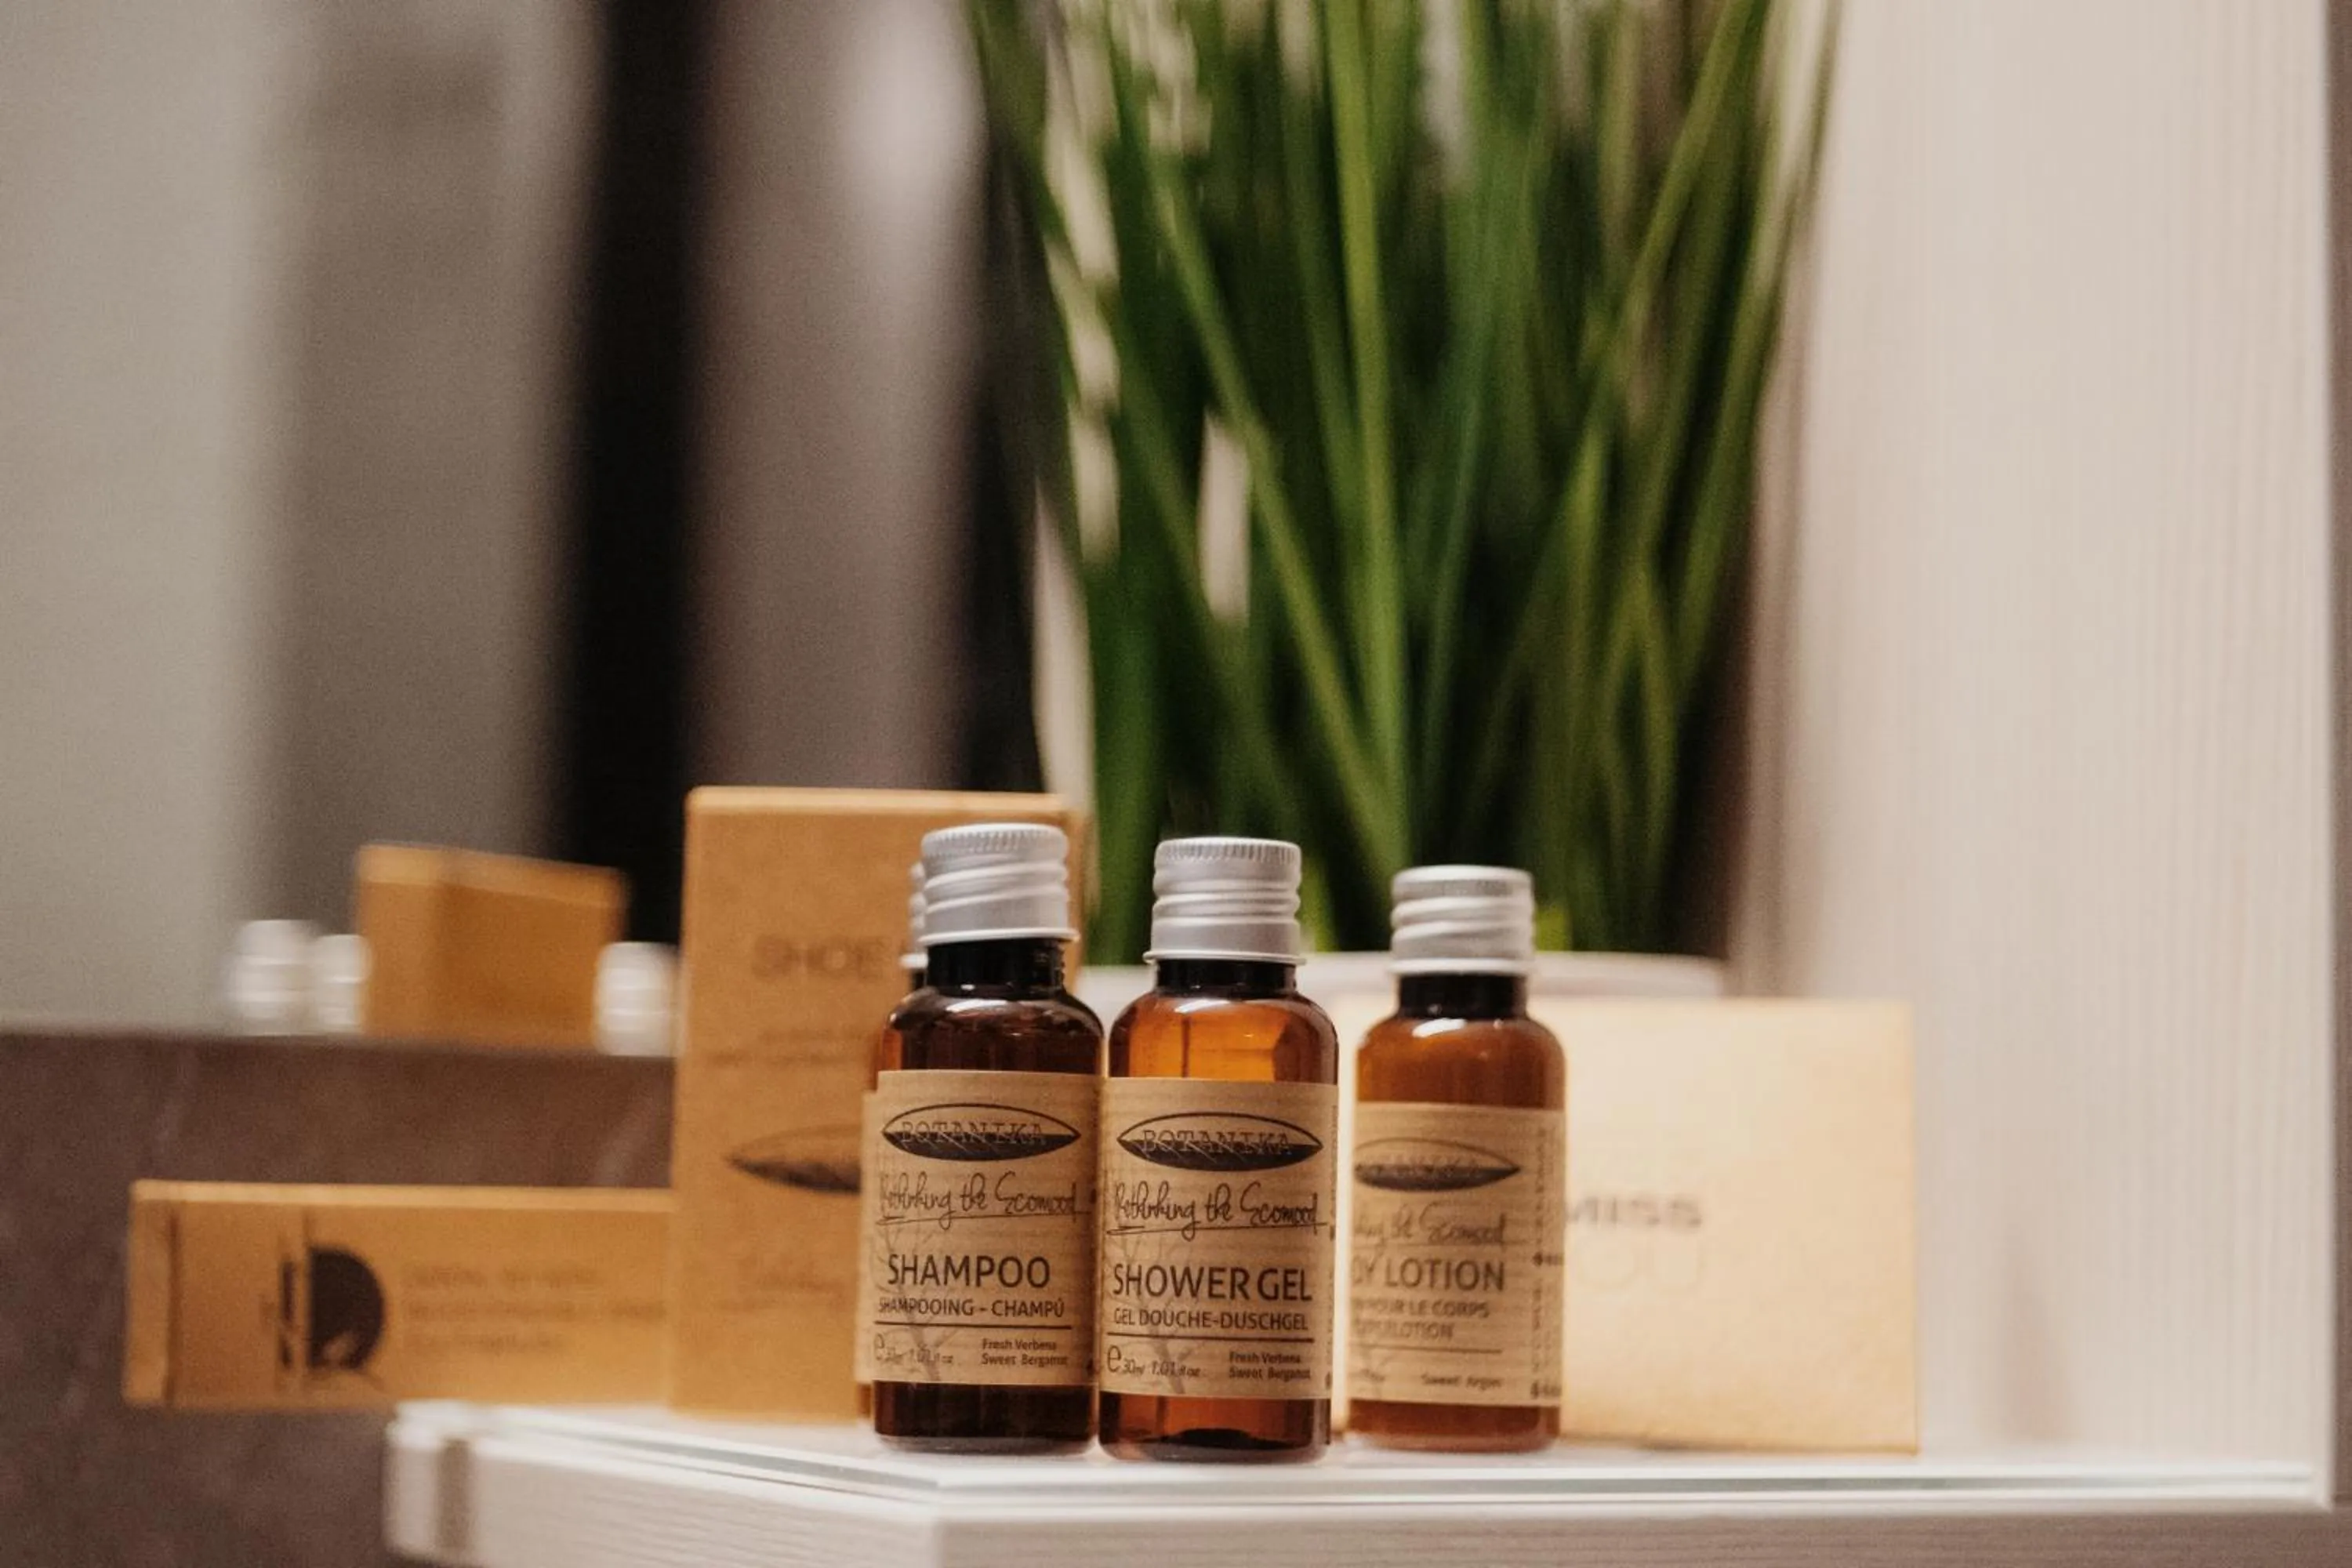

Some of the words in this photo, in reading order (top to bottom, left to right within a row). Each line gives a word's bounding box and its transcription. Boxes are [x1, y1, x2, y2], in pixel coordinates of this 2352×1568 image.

[902, 1121, 1047, 1145] BOTANIKA
[1142, 1130, 1293, 1156] BOTANIKA
[960, 1173, 988, 1212] the
[1204, 1183, 1234, 1223] the
[887, 1254, 1051, 1288] SHAMPOO
[1112, 1263, 1250, 1301] SHOWER
[1256, 1268, 1313, 1302] GEL
[1385, 1258, 1504, 1292] LOTION
[1114, 1308, 1135, 1326] GEL
[982, 1338, 1012, 1349] Fresh
[1014, 1338, 1056, 1350] Verbena
[982, 1353, 1016, 1365] Sweet
